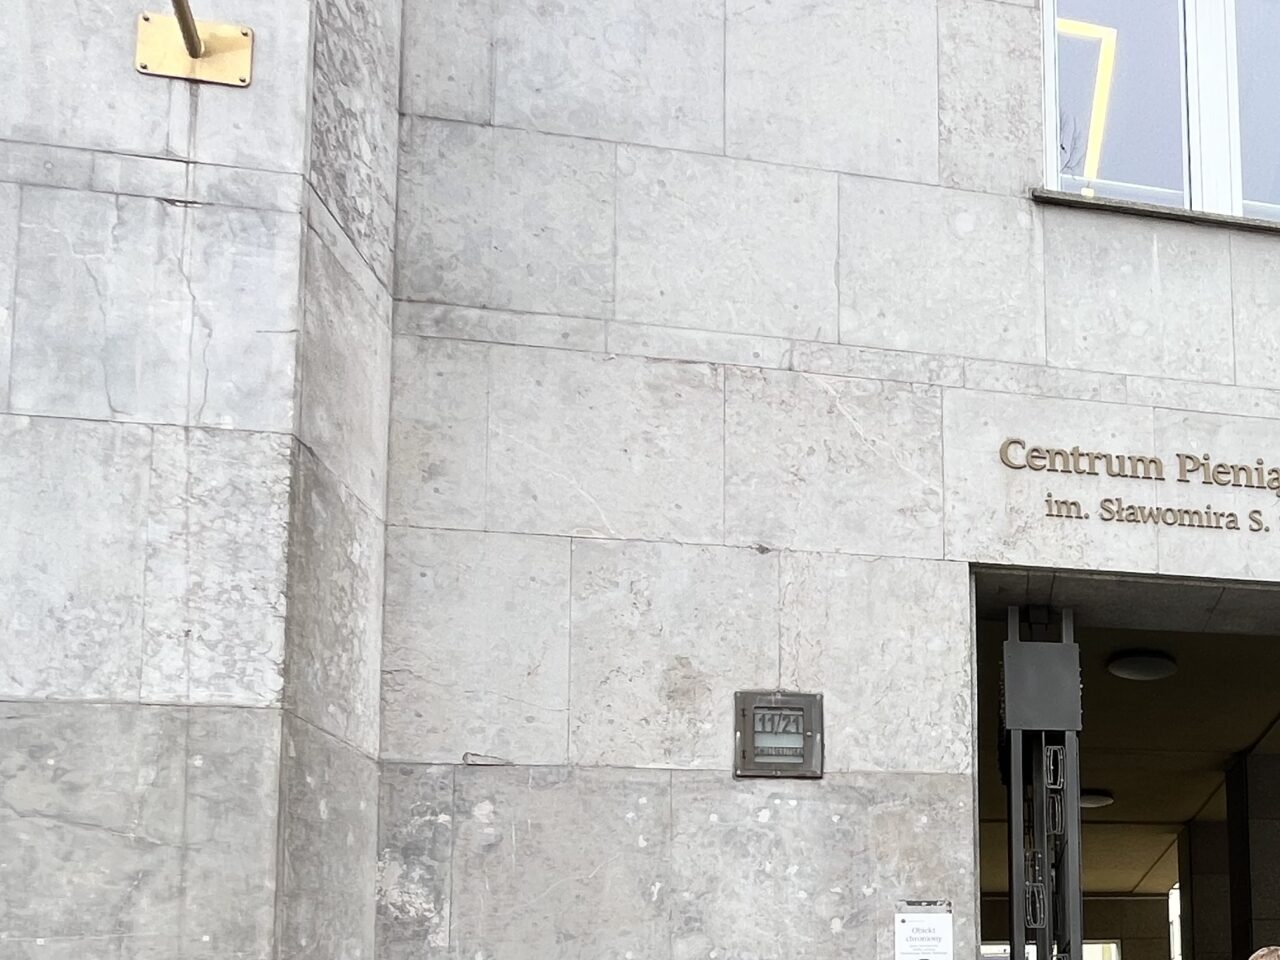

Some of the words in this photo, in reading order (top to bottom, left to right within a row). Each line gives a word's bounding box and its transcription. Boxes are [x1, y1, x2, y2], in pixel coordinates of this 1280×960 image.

[999, 437, 1166, 481] Centrum
[1044, 491, 1090, 520] im.
[1099, 496, 1241, 531] Sławomira
[1248, 509, 1270, 532] S.
